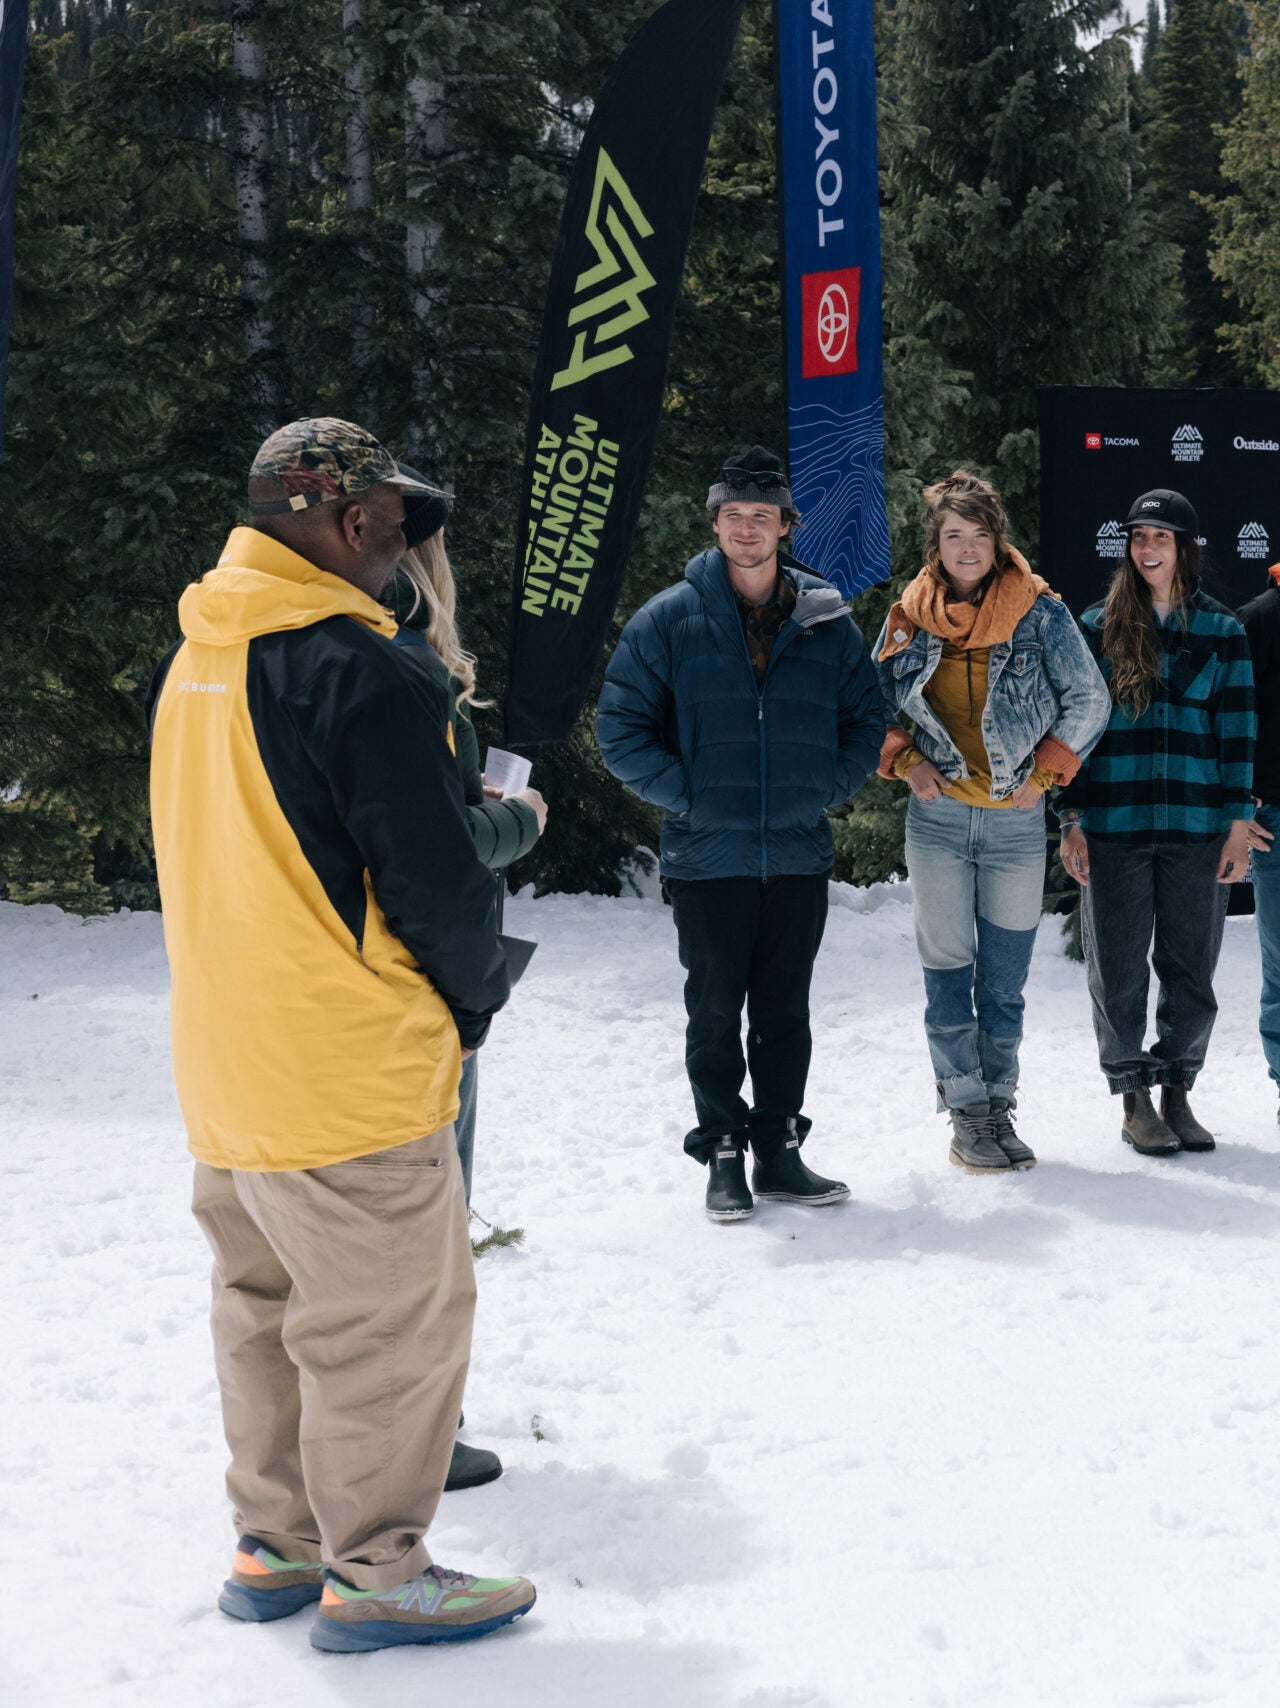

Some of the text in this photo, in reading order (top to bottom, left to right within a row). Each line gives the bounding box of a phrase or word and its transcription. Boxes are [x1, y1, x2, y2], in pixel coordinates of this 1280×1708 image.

[811, 0, 844, 247] TOYOTA
[521, 413, 599, 617] MOUNTAIN
[551, 438, 620, 616] ULTIMATE
[1103, 437, 1140, 446] TACOMA
[1232, 435, 1280, 451] Outside
